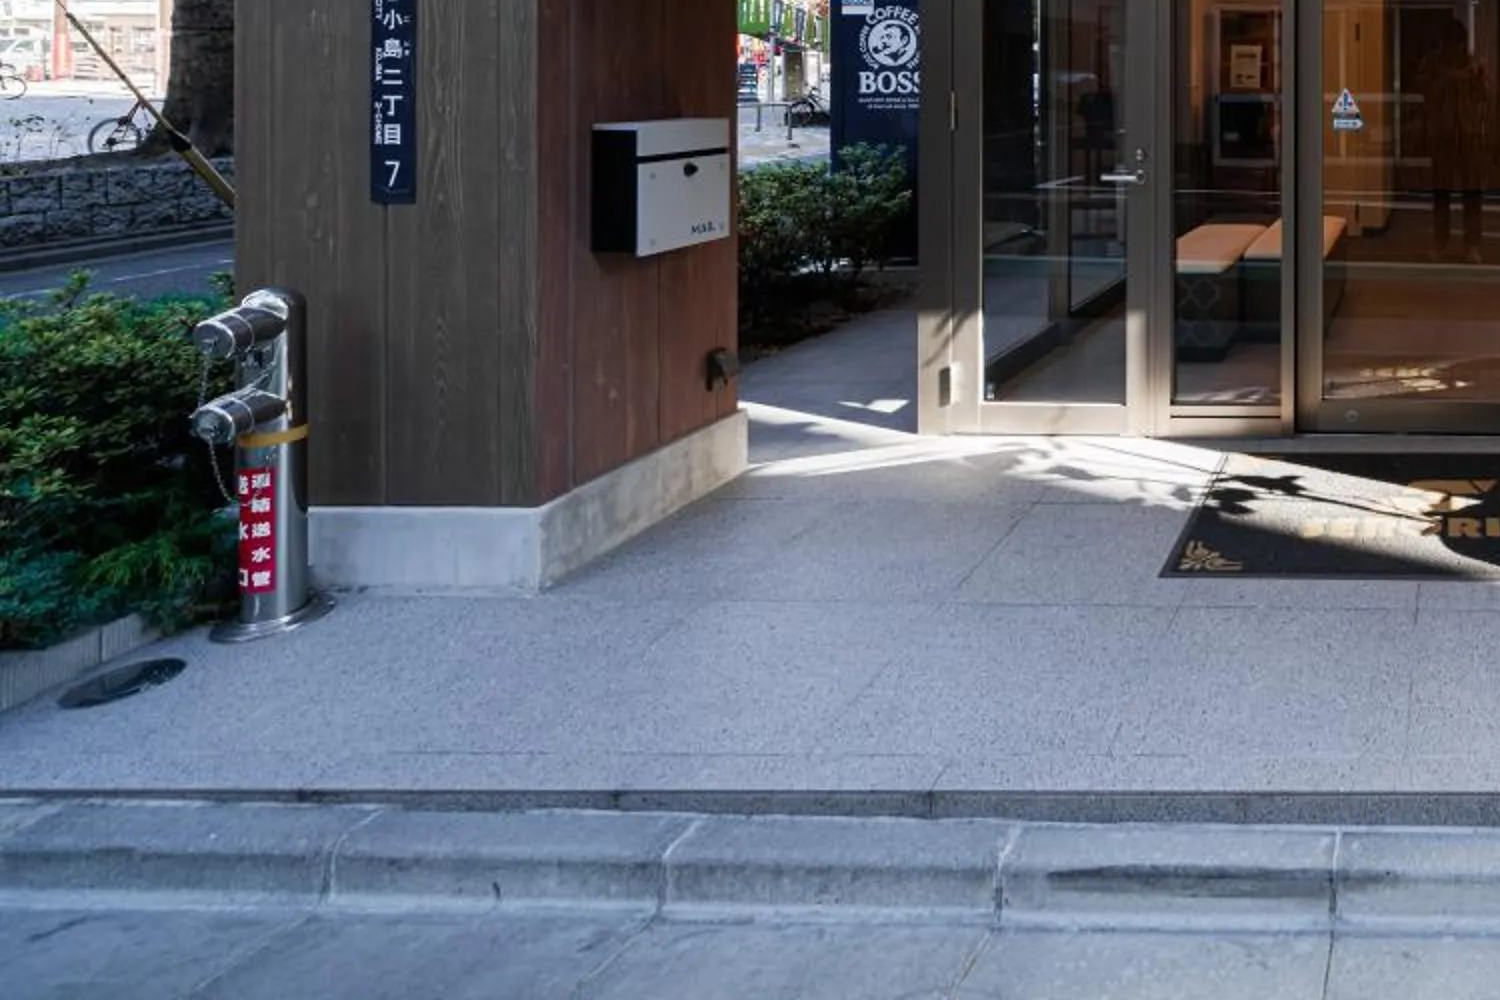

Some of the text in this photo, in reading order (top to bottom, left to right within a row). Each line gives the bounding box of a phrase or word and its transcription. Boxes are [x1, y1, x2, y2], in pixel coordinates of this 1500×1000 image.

[866, 5, 919, 25] COFFEE
[382, 9, 403, 145] 小島二丁目
[385, 161, 400, 187] 7
